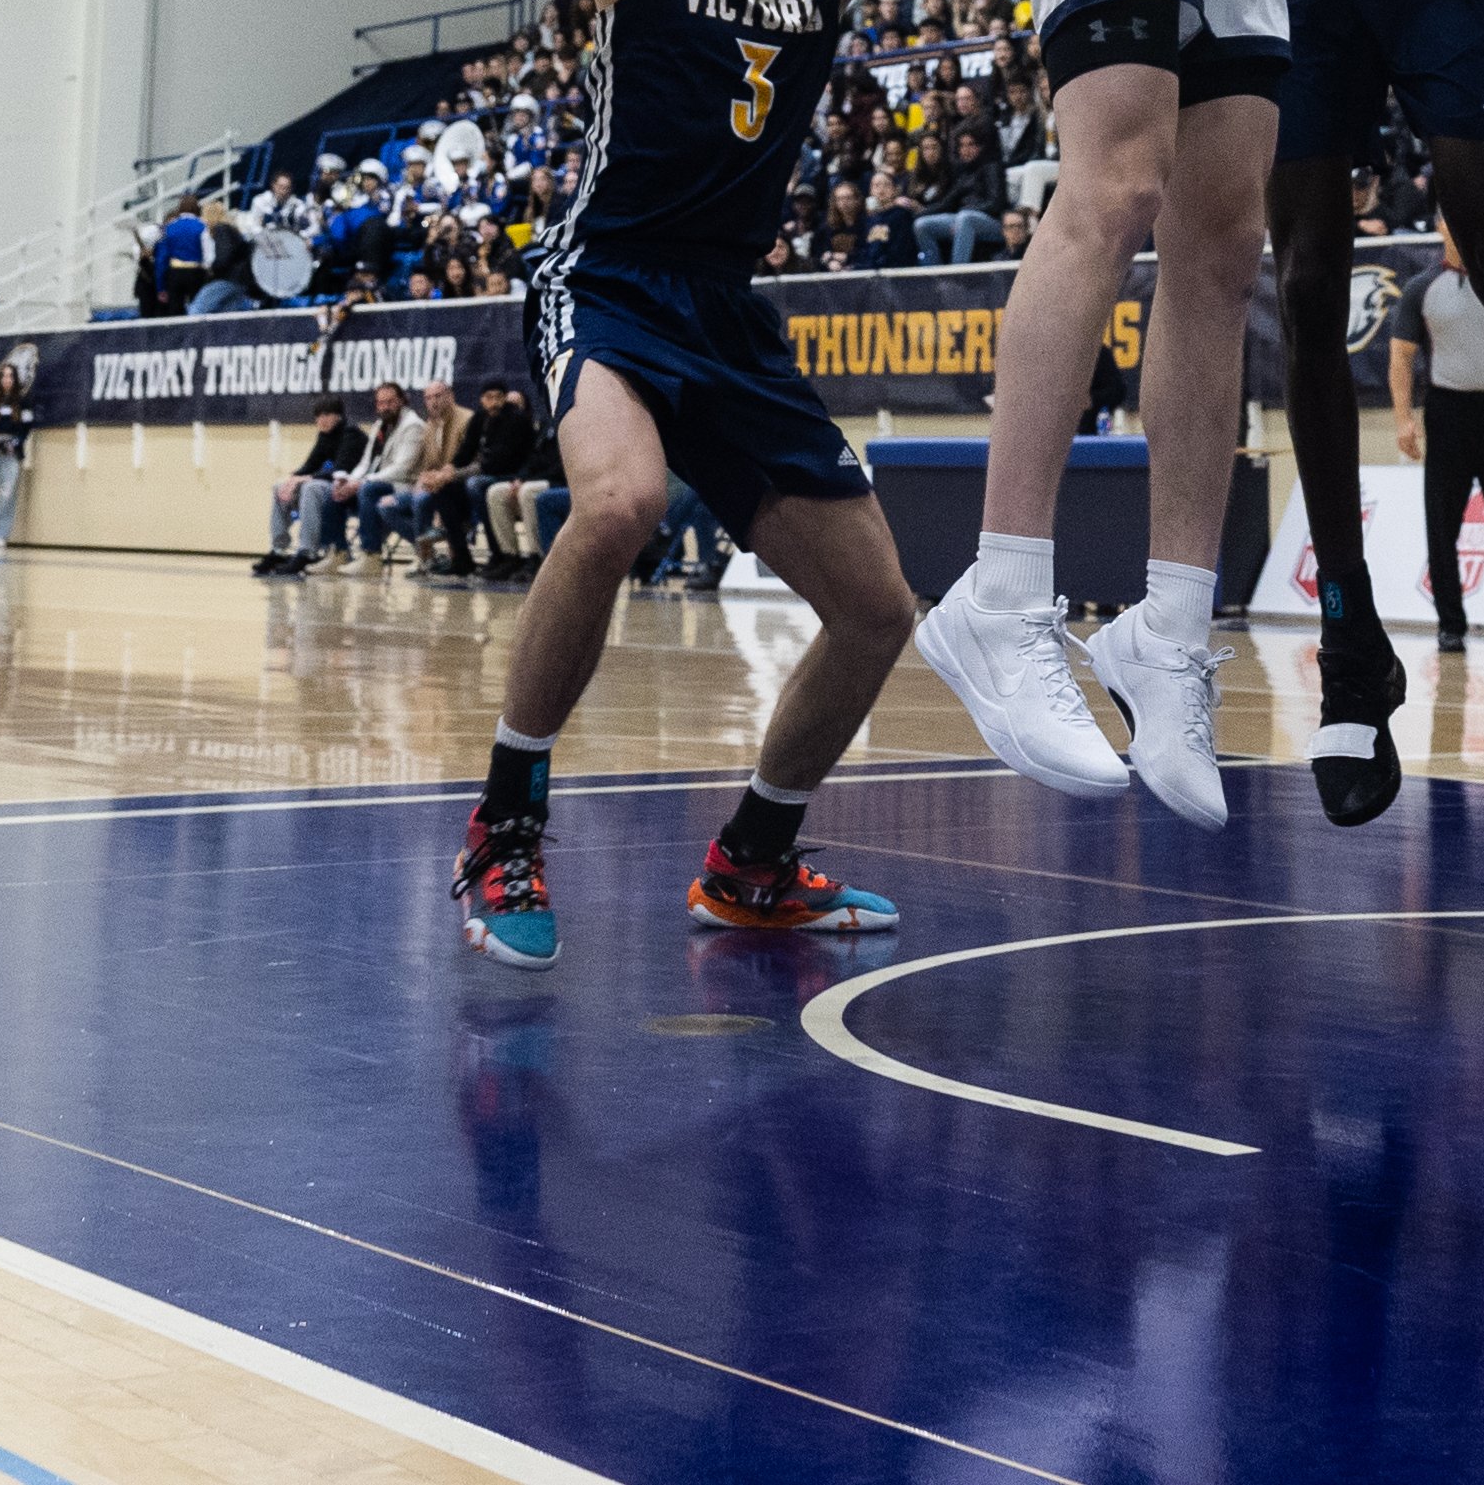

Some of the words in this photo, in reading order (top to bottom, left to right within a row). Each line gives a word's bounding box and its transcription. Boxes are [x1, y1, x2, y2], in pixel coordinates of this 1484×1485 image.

[731, 37, 783, 142] 3
[92, 348, 197, 400] VICTORY
[202, 343, 323, 395] THROUGH
[328, 336, 457, 393] HONOUR
